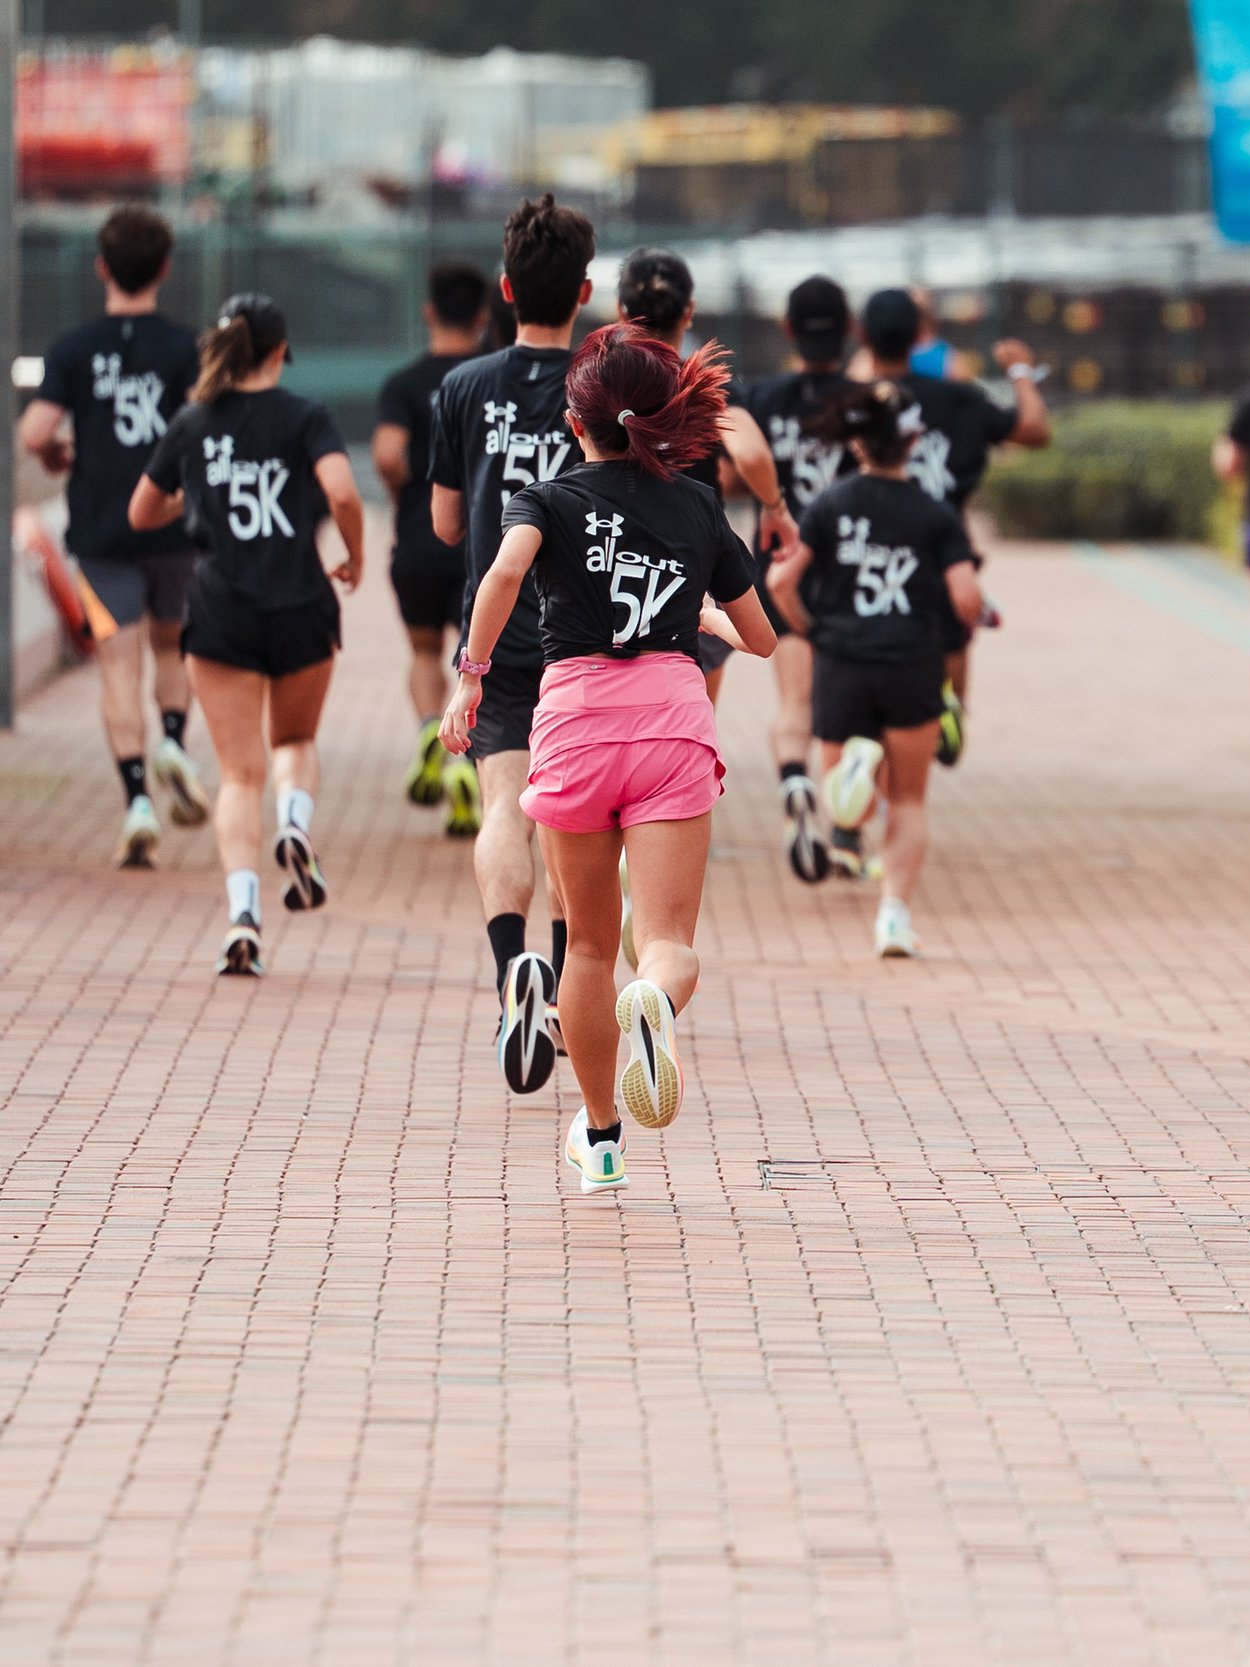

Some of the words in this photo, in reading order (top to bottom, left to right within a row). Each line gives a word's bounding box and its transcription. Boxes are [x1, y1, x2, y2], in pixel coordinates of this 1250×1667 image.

[113, 379, 168, 447] 5K
[228, 466, 296, 541] 5K
[853, 549, 919, 617] 5K
